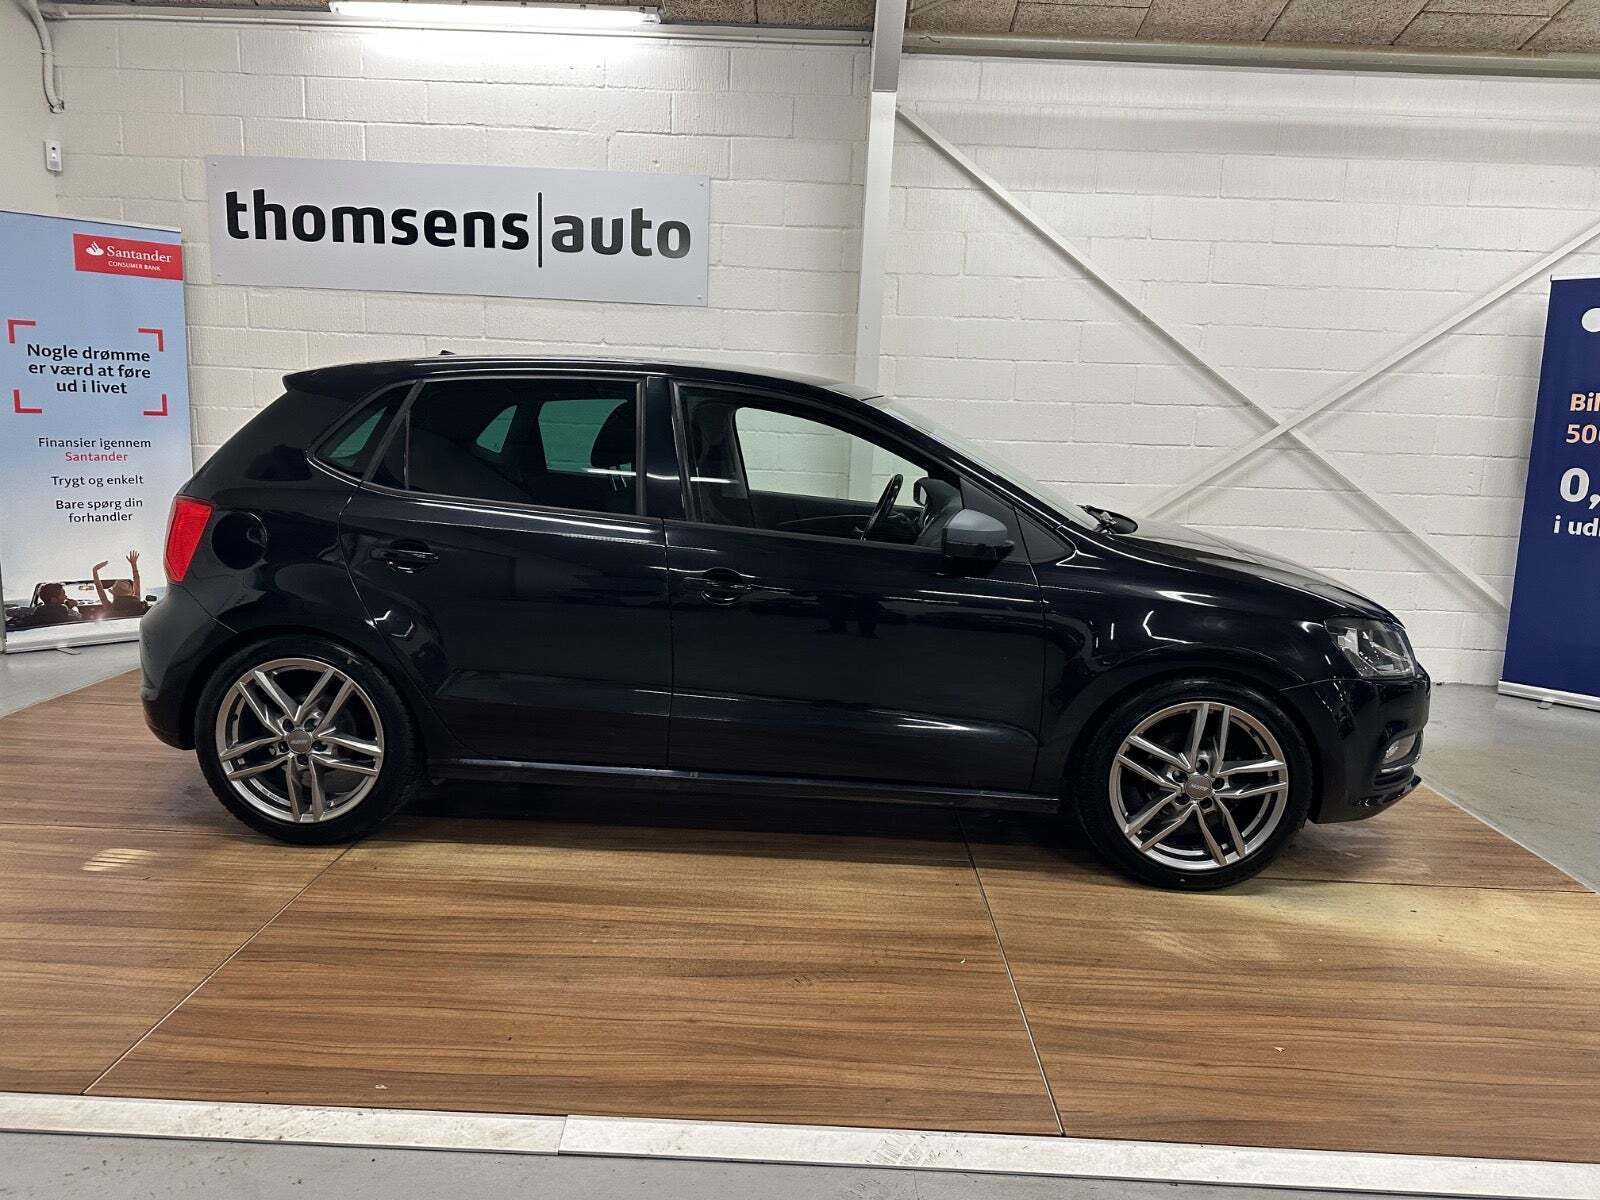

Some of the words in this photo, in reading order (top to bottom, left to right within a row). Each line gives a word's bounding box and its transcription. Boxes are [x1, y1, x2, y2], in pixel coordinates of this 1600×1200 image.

[225, 188, 529, 251] thomsens
[552, 207, 692, 259] auto
[106, 245, 172, 263] Santander
[108, 260, 142, 270] CONSUMER
[27, 343, 78, 361] Nogle
[82, 346, 150, 362] drømme
[28, 363, 46, 374] er
[50, 363, 94, 376] værd
[98, 365, 114, 377] at
[118, 364, 151, 379] føre
[56, 379, 78, 393] ud
[82, 380, 87, 393] i
[91, 380, 127, 394] livet
[1566, 423, 1600, 444] 50
[38, 437, 97, 448] Finansier
[99, 438, 151, 450] igennem
[65, 451, 128, 462] Santander
[51, 475, 86, 488] Trygt
[88, 477, 104, 488] og
[106, 474, 144, 485] enkelt
[55, 499, 84, 510] Bare
[87, 500, 122, 511] spørg
[124, 498, 143, 508] din
[68, 511, 133, 523] forhandler
[1553, 515, 1561, 534] i
